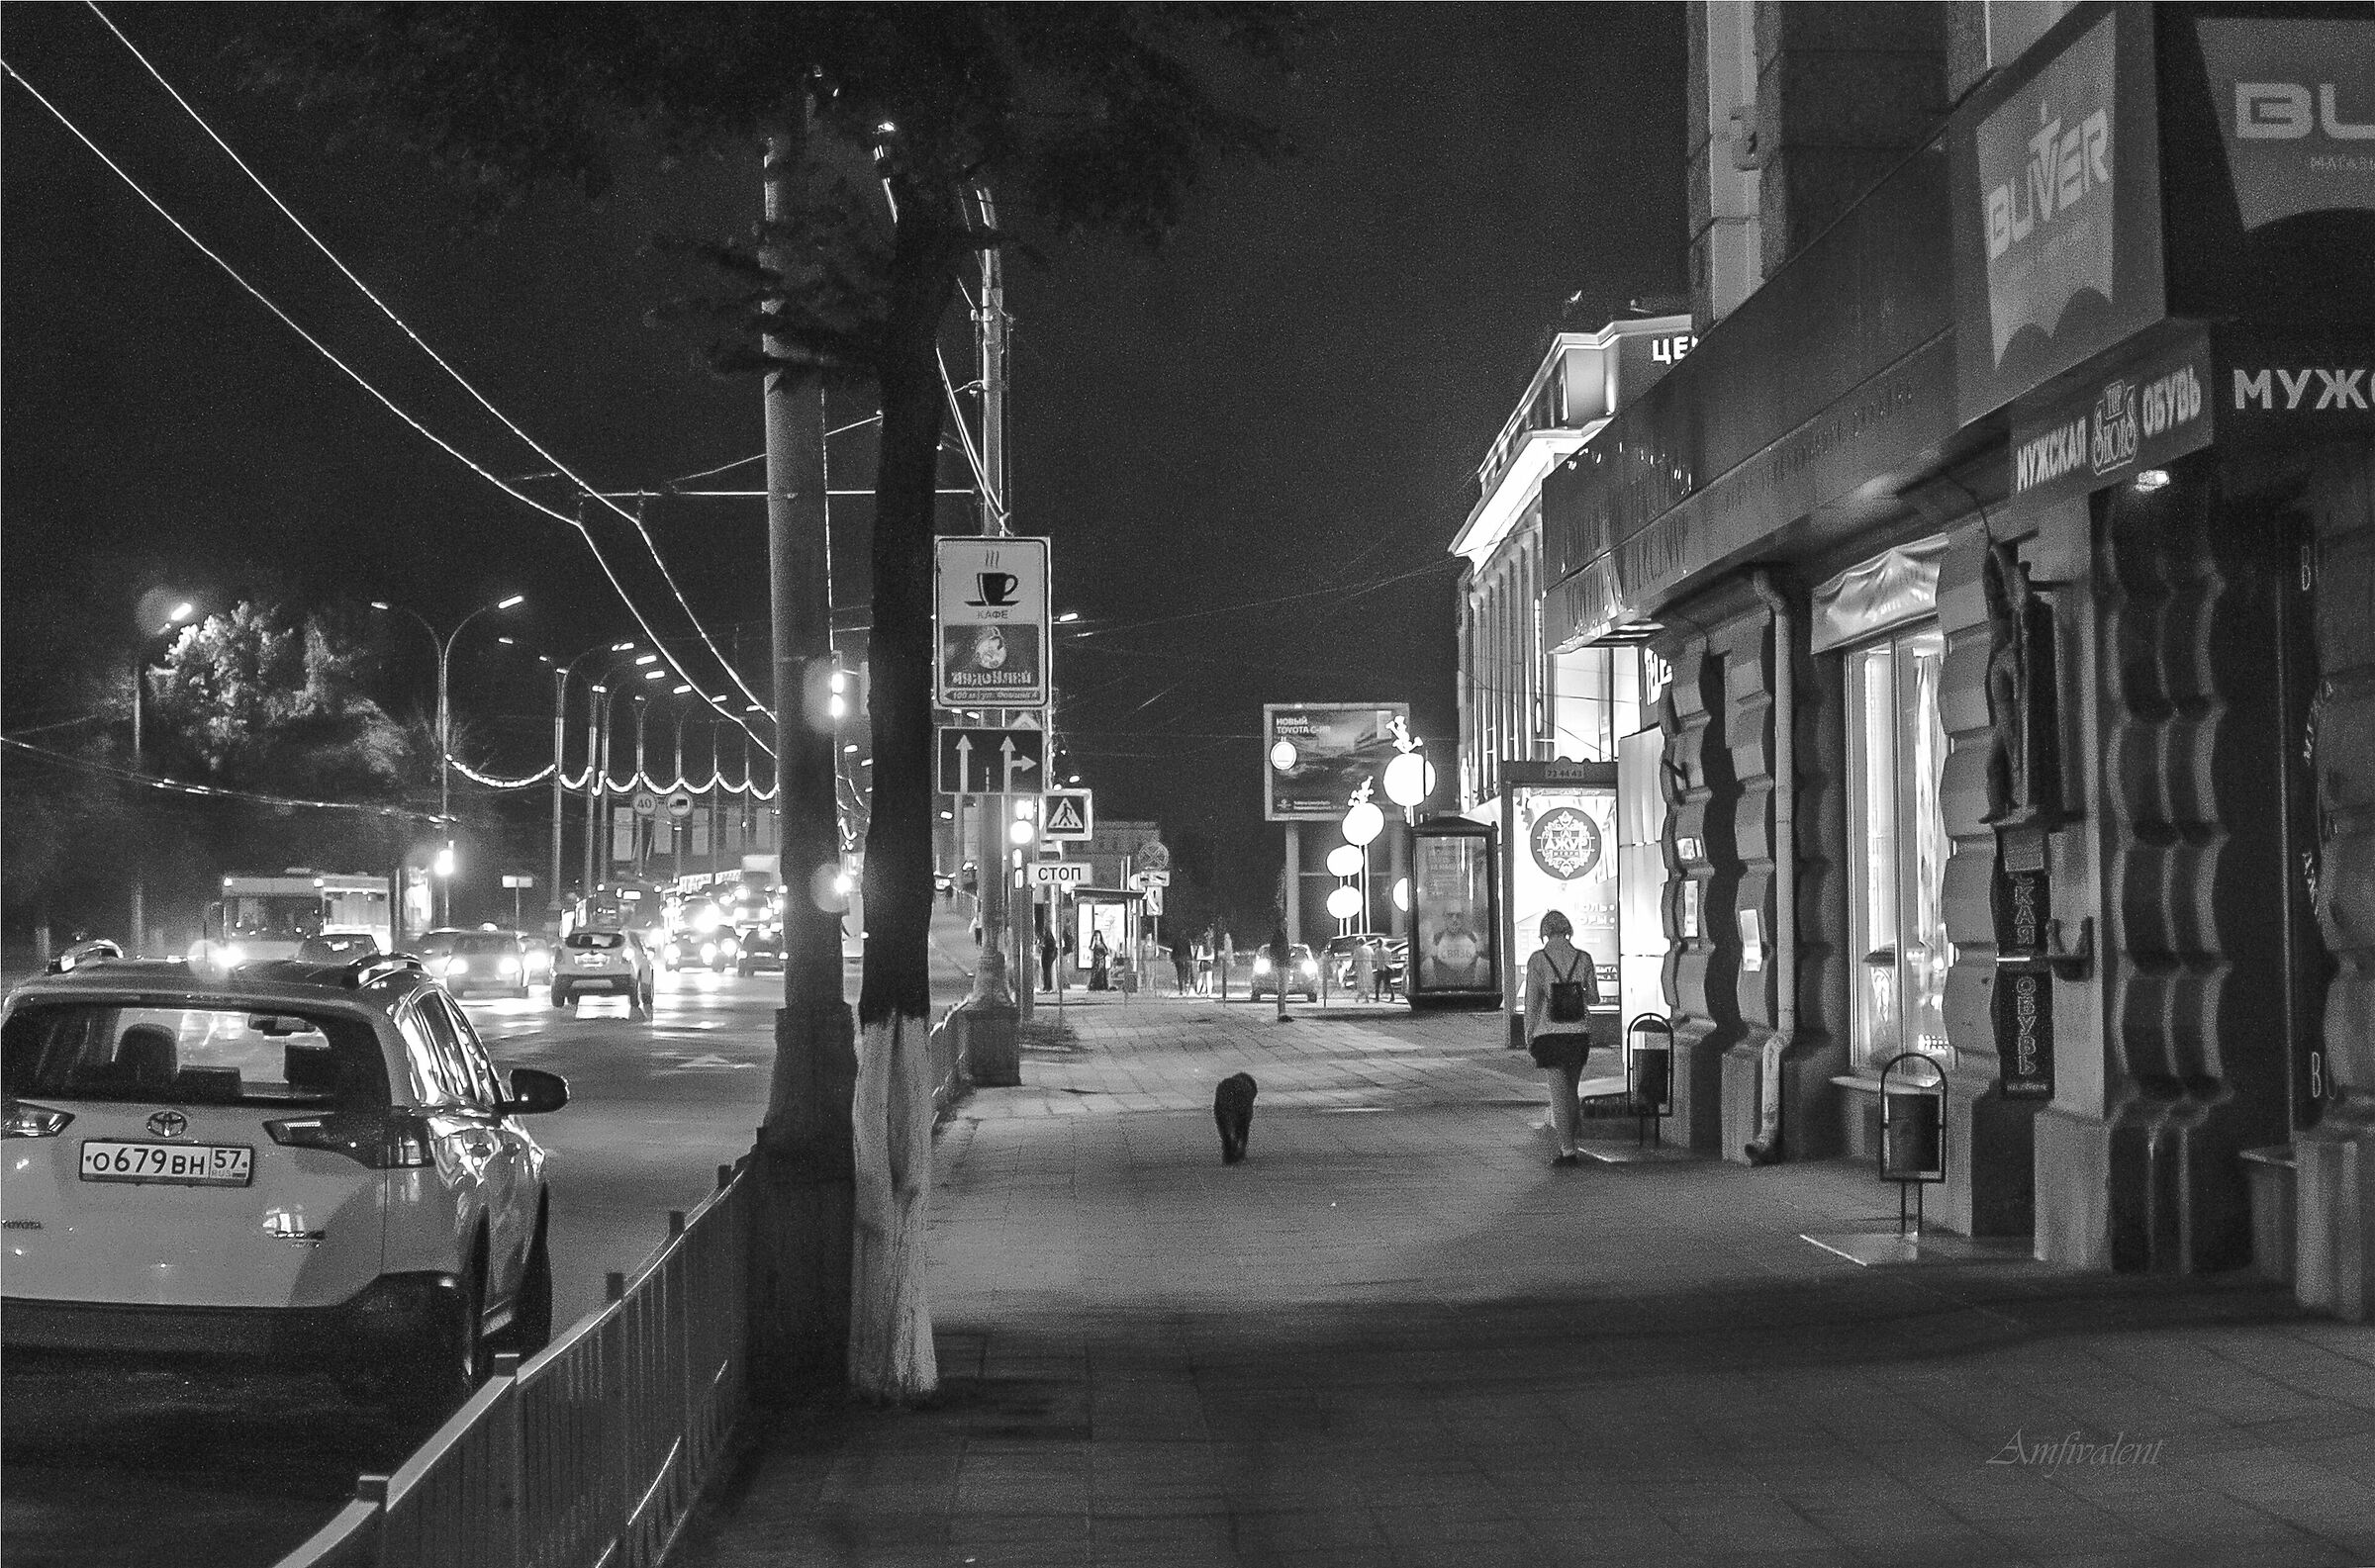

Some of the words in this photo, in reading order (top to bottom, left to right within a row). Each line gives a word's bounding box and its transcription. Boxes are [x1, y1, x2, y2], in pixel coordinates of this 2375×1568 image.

[2233, 369, 2375, 410] МУЖ
[2017, 415, 2087, 493] МУЖСКАЯ
[2142, 364, 2202, 438] ОБУВЬ
[977, 609, 1009, 619] КАФЕ
[1277, 715, 1308, 725] НОВЫЙ
[637, 798, 652, 808] 40
[1038, 867, 1081, 880] СТОП
[2016, 975, 2038, 1075] ОБУВЬ
[214, 1150, 241, 1170] 57
